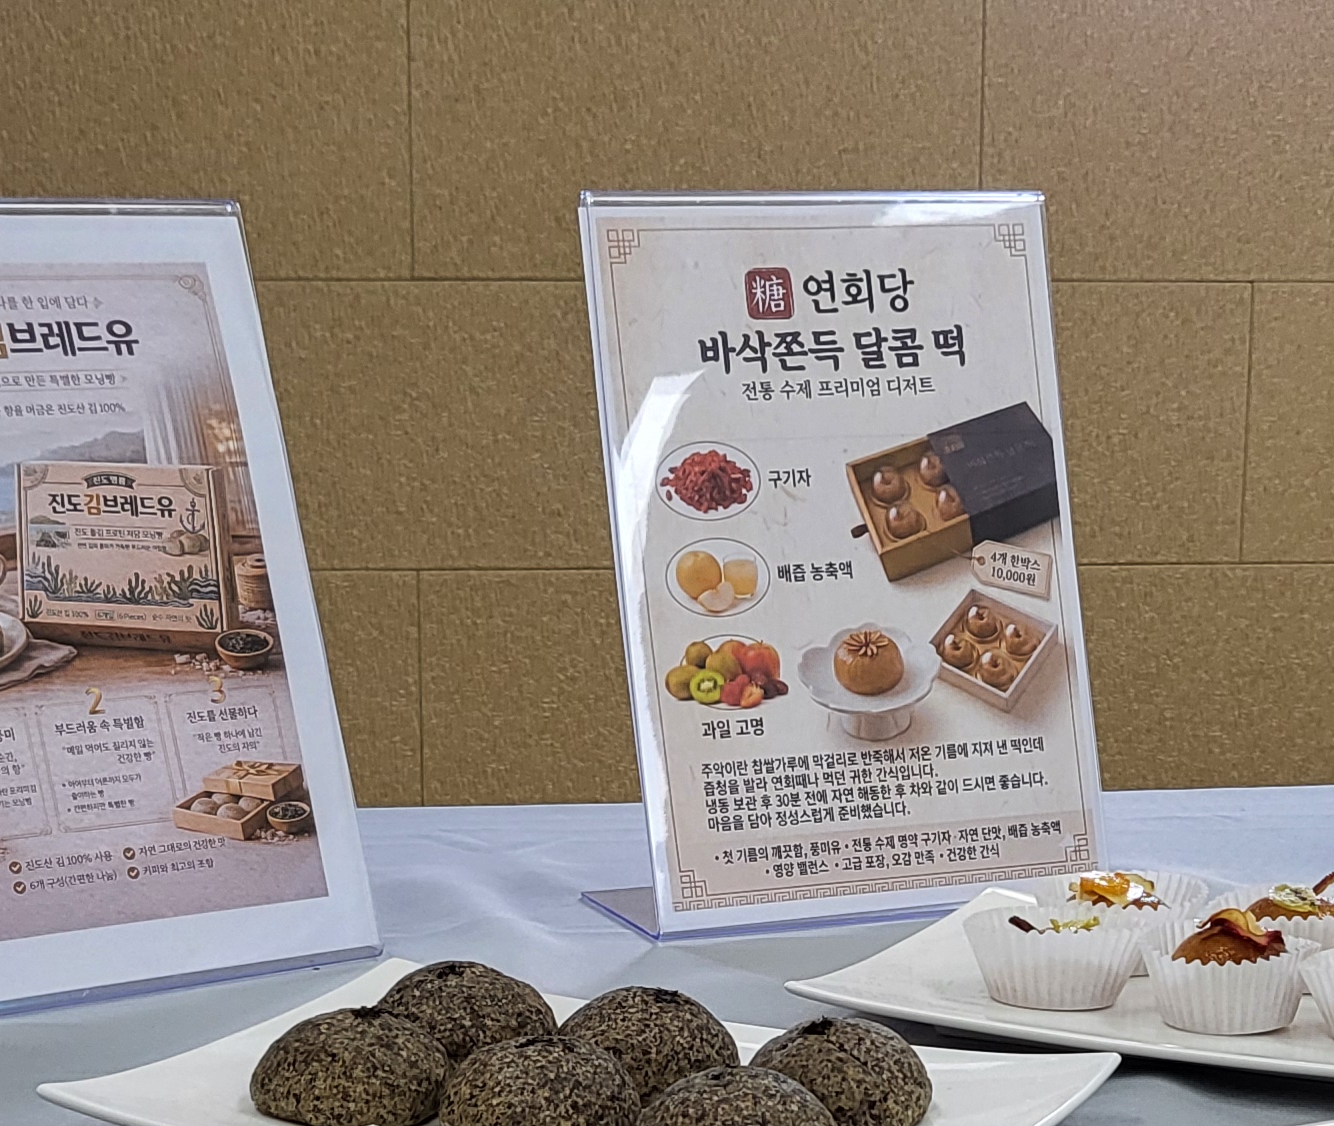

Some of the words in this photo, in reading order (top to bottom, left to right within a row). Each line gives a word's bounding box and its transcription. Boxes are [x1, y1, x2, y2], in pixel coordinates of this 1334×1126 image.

[21, 296, 34, 309] 한
[37, 295, 62, 310] 입에
[750, 273, 788, 314] 糖
[802, 267, 915, 314] 연회당
[697, 329, 845, 375] 바삭쫀득
[852, 326, 925, 370] 달콤
[931, 323, 966, 367] 떡
[24, 375, 46, 388] 만든
[49, 374, 81, 387] 특별한
[84, 373, 116, 386] 모닝빵
[741, 380, 775, 402] 전통
[779, 379, 812, 400] 수제
[817, 376, 881, 399] 프리미엄
[886, 375, 936, 396] 디저트
[4, 404, 23, 417] 향을
[26, 403, 55, 416] 머금은
[57, 402, 85, 415] 진도산
[767, 468, 812, 488] 구기자
[48, 493, 177, 519] 진도김브레드유
[777, 562, 807, 584] 배즙
[809, 560, 854, 582] 농축액
[989, 566, 1037, 587] 10,000원
[85, 687, 106, 715] 2
[208, 676, 226, 704] 3
[186, 709, 217, 725] 진도를
[218, 705, 259, 721] 선물하다
[54, 721, 98, 737] 부드러움
[701, 719, 732, 741] 과일
[735, 716, 765, 738] 고명
[701, 760, 749, 780] 주악이란
[751, 755, 811, 776] 찹쌀가루에
[812, 751, 859, 769] 막걸리로
[860, 747, 907, 767] 반죽해서
[908, 745, 933, 763] 저온
[935, 742, 969, 761] 기름에
[1010, 736, 1045, 753] 떡인데
[703, 779, 741, 798] 즙청을
[743, 776, 769, 795] 발라
[822, 769, 846, 787] 먹던
[849, 768, 874, 786] 귀한
[875, 763, 940, 784] 간식입니다.
[705, 797, 731, 815] 냉동
[733, 795, 758, 813] 보관
[776, 791, 802, 809] 30분
[805, 789, 829, 807] 전에
[831, 786, 855, 804] 자연
[856, 782, 892, 802] 해동한
[909, 781, 933, 798] 차와
[935, 778, 959, 796] 같이
[962, 774, 997, 793] 드시면
[998, 771, 1049, 791] 좋습니다.
[707, 813, 745, 833] 마음을
[747, 812, 773, 830] 담아
[775, 806, 836, 827] 정성스럽게
[837, 801, 911, 821] 준비했습니다.
[139, 846, 157, 857] 자연
[158, 842, 192, 855] 그대로의
[193, 838, 217, 851] 건강한
[25, 858, 54, 872] 진도산
[67, 853, 92, 867] 100%
[94, 850, 113, 863] 사용
[171, 860, 196, 872] 최고의
[197, 858, 215, 869] 조합
[772, 862, 796, 880] 영양
[946, 845, 978, 863] 건강한
[979, 843, 1001, 860] 간식
[30, 879, 46, 891] 6개
